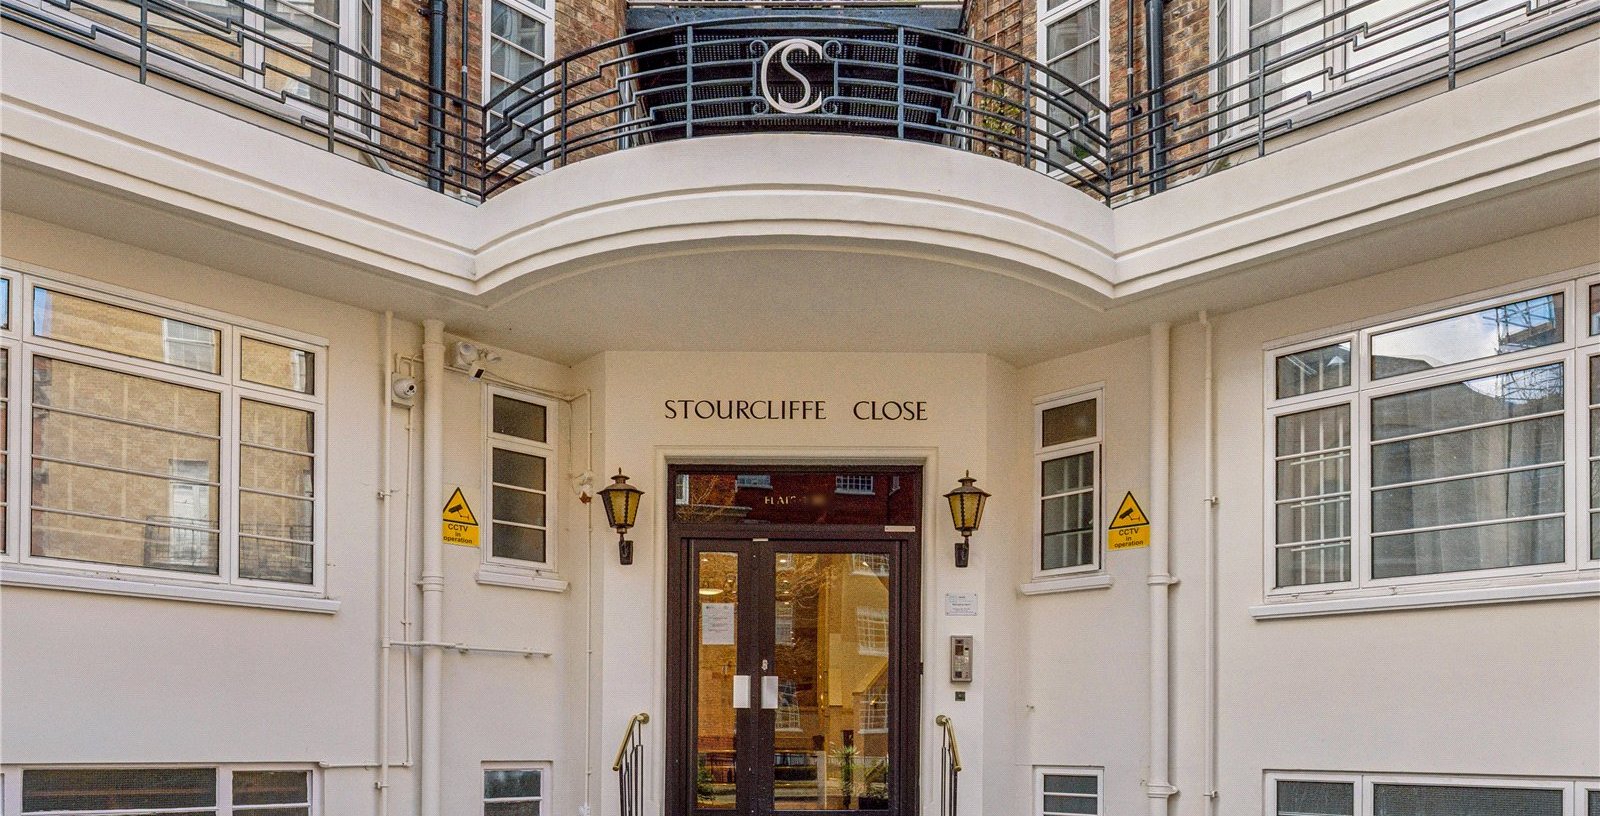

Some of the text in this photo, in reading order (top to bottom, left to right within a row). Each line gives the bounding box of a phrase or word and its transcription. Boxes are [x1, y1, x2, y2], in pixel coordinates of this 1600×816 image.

[664, 399, 928, 421] STOURCLIFFE CLOSE
[447, 523, 469, 532] CCTV
[1118, 527, 1140, 536] CCTV
[443, 535, 473, 544] operation
[1114, 540, 1144, 549] operation
